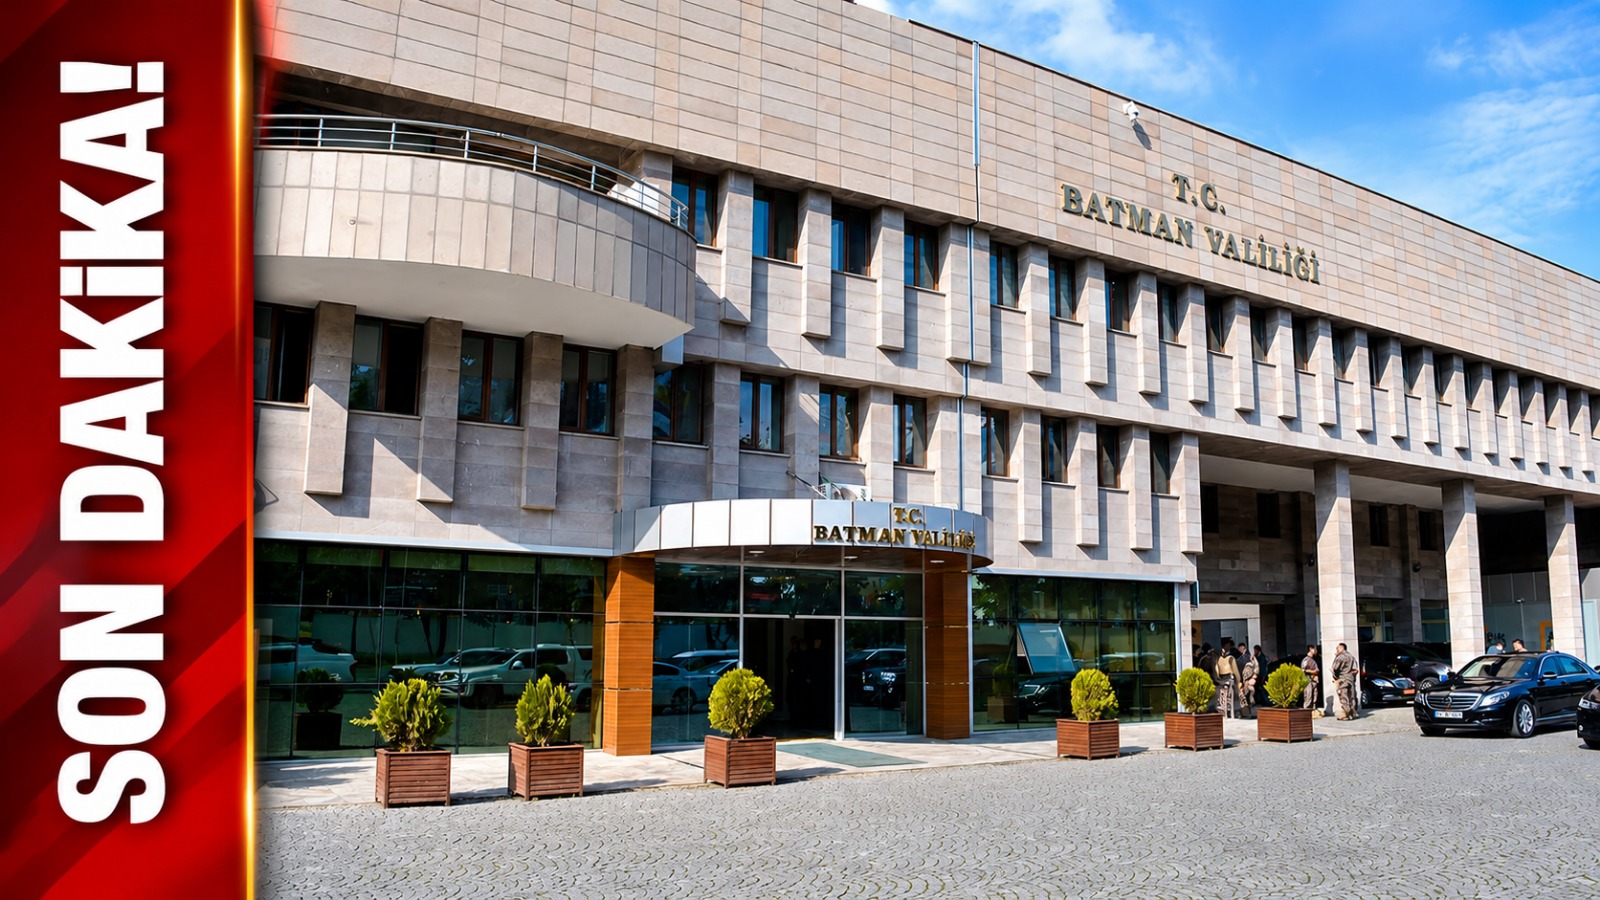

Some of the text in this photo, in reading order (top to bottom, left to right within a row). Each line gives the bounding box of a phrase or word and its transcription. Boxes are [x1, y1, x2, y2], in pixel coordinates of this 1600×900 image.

[1171, 173, 1226, 215] T.C.
[1061, 183, 1320, 285] BATMAN VALİLİĞİ
[893, 506, 923, 525] T.C.
[814, 525, 907, 545] BATMAN
